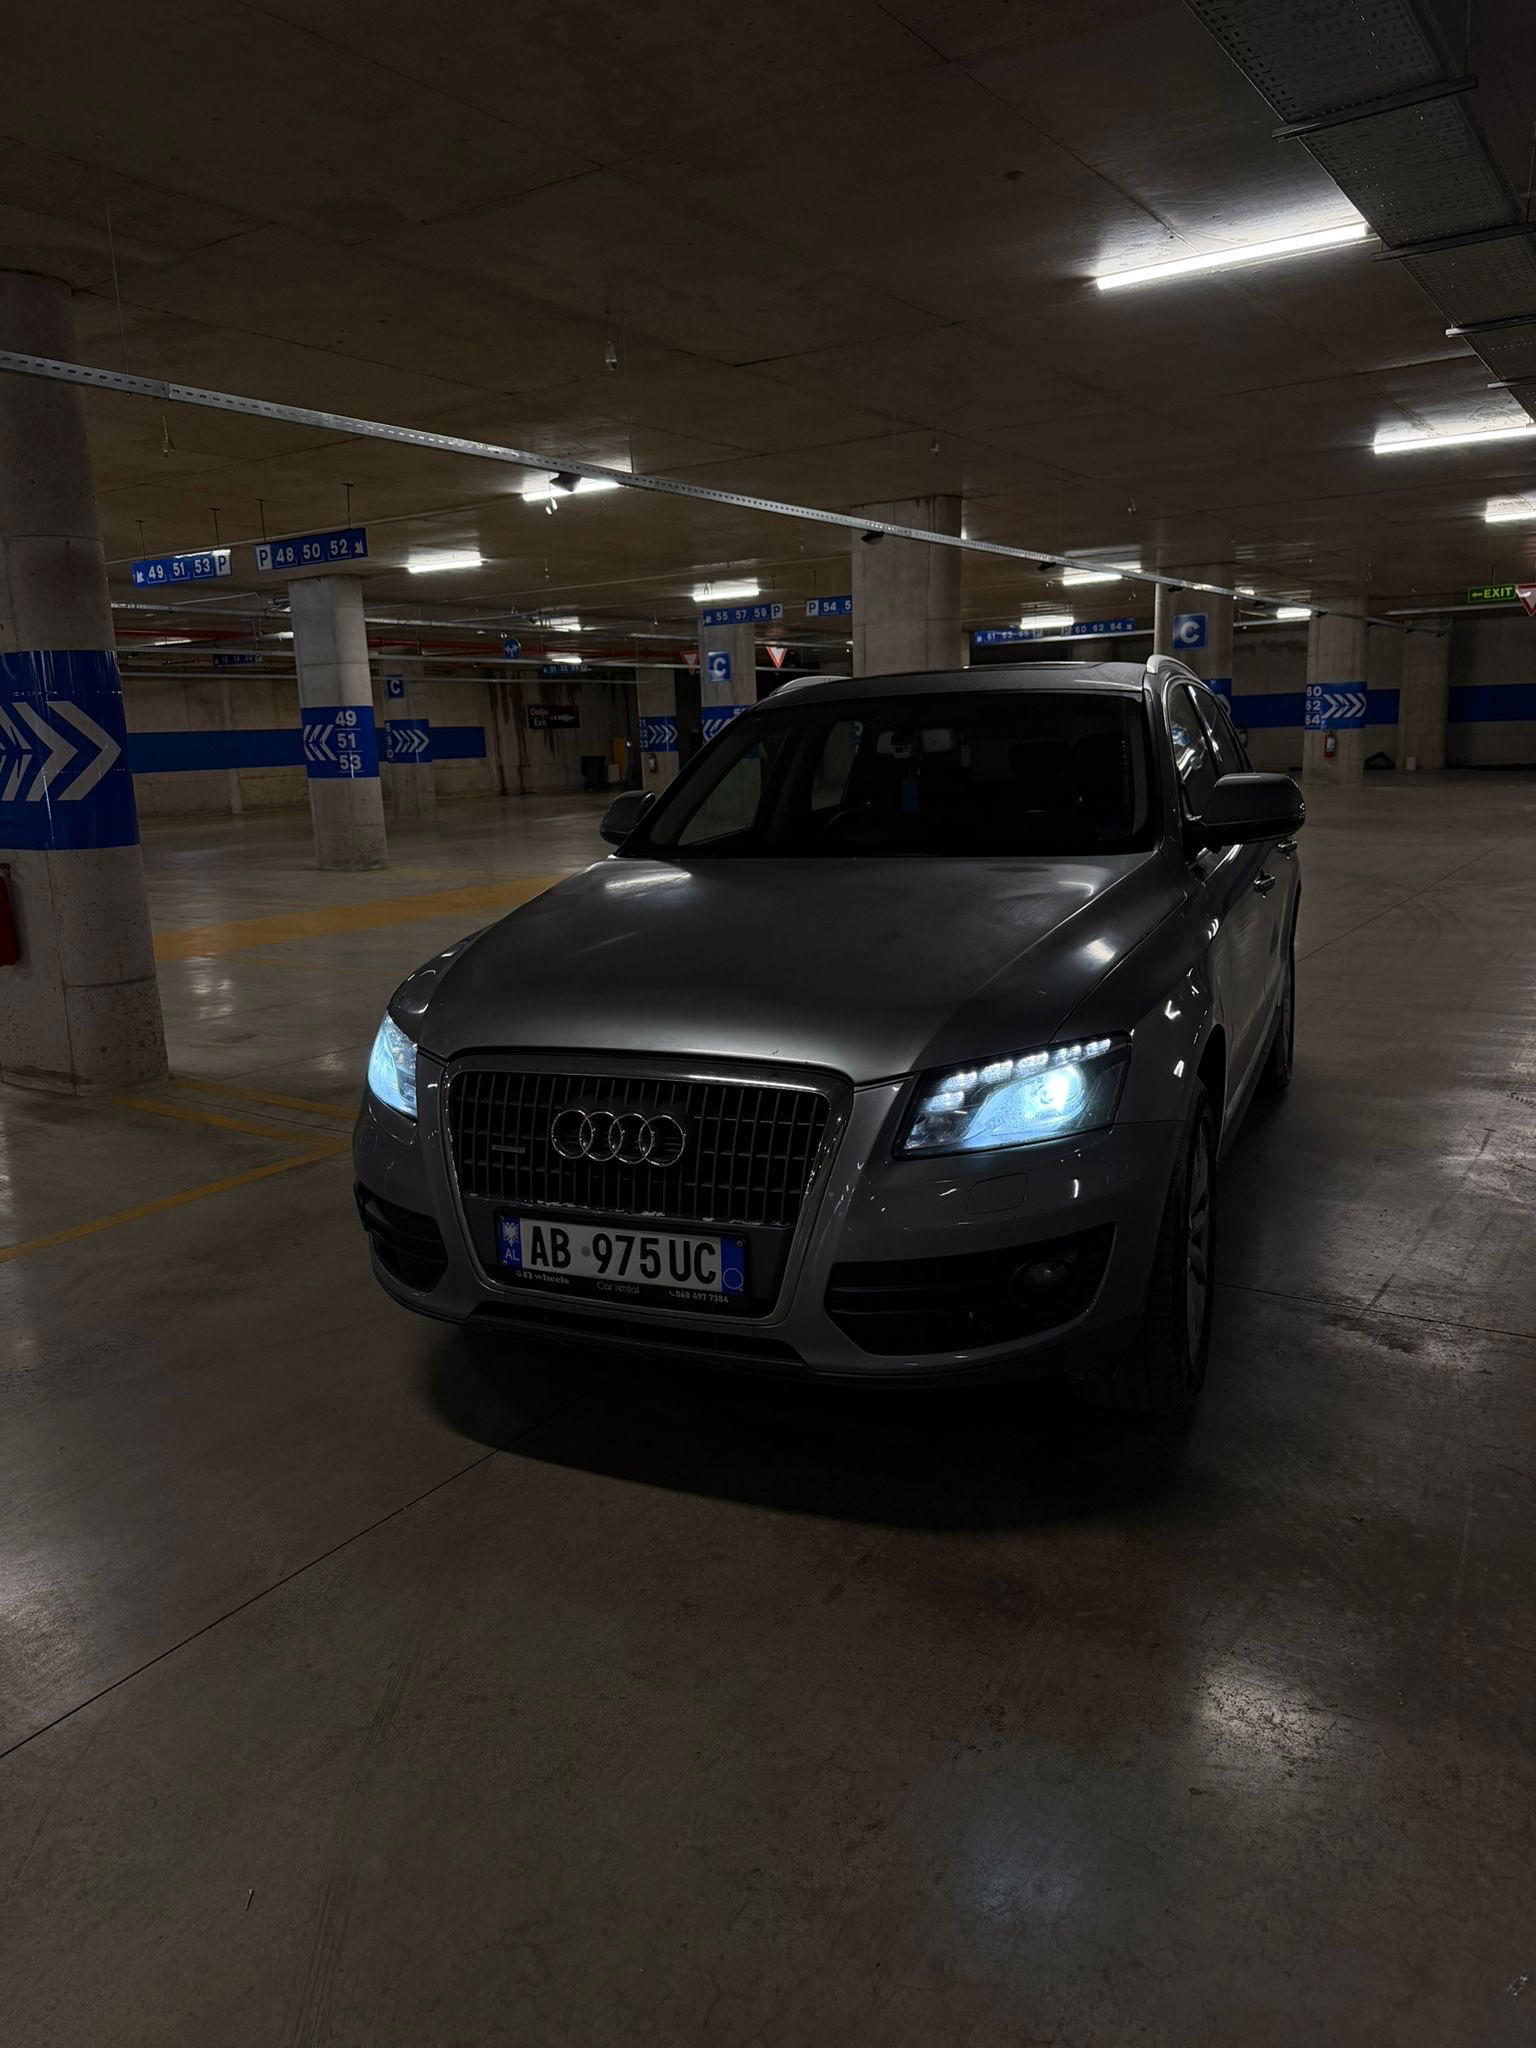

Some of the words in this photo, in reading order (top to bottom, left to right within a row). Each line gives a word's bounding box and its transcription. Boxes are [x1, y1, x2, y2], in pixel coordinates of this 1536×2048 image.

[260, 551, 269, 566] P
[275, 547, 294, 564] 48
[302, 543, 321, 560] 50
[329, 538, 348, 556] 52
[148, 566, 163, 580] 49
[172, 562, 185, 576] 51
[194, 558, 211, 573] 53
[219, 557, 227, 572] P
[1483, 587, 1513, 598] EXIT
[716, 611, 728, 622] 55
[735, 609, 747, 620] 57
[754, 607, 767, 618] 59
[774, 605, 781, 616] P
[808, 602, 816, 613] P
[823, 601, 837, 612] 54
[844, 600, 852, 610] 5
[1074, 625, 1087, 634] 60
[1092, 624, 1104, 633] 62
[1110, 622, 1122, 631] 64
[1179, 621, 1201, 644] C
[713, 657, 727, 677] C
[390, 680, 402, 695] C
[1306, 686, 1322, 697] 60
[1305, 700, 1321, 711] 62
[335, 710, 357, 727] 49
[1304, 714, 1321, 725] 64
[337, 732, 357, 749] 51
[339, 754, 362, 770] 53
[505, 1249, 520, 1262] AL
[531, 1226, 571, 1268] AB
[592, 1233, 661, 1279] 975
[668, 1239, 717, 1284] UC
